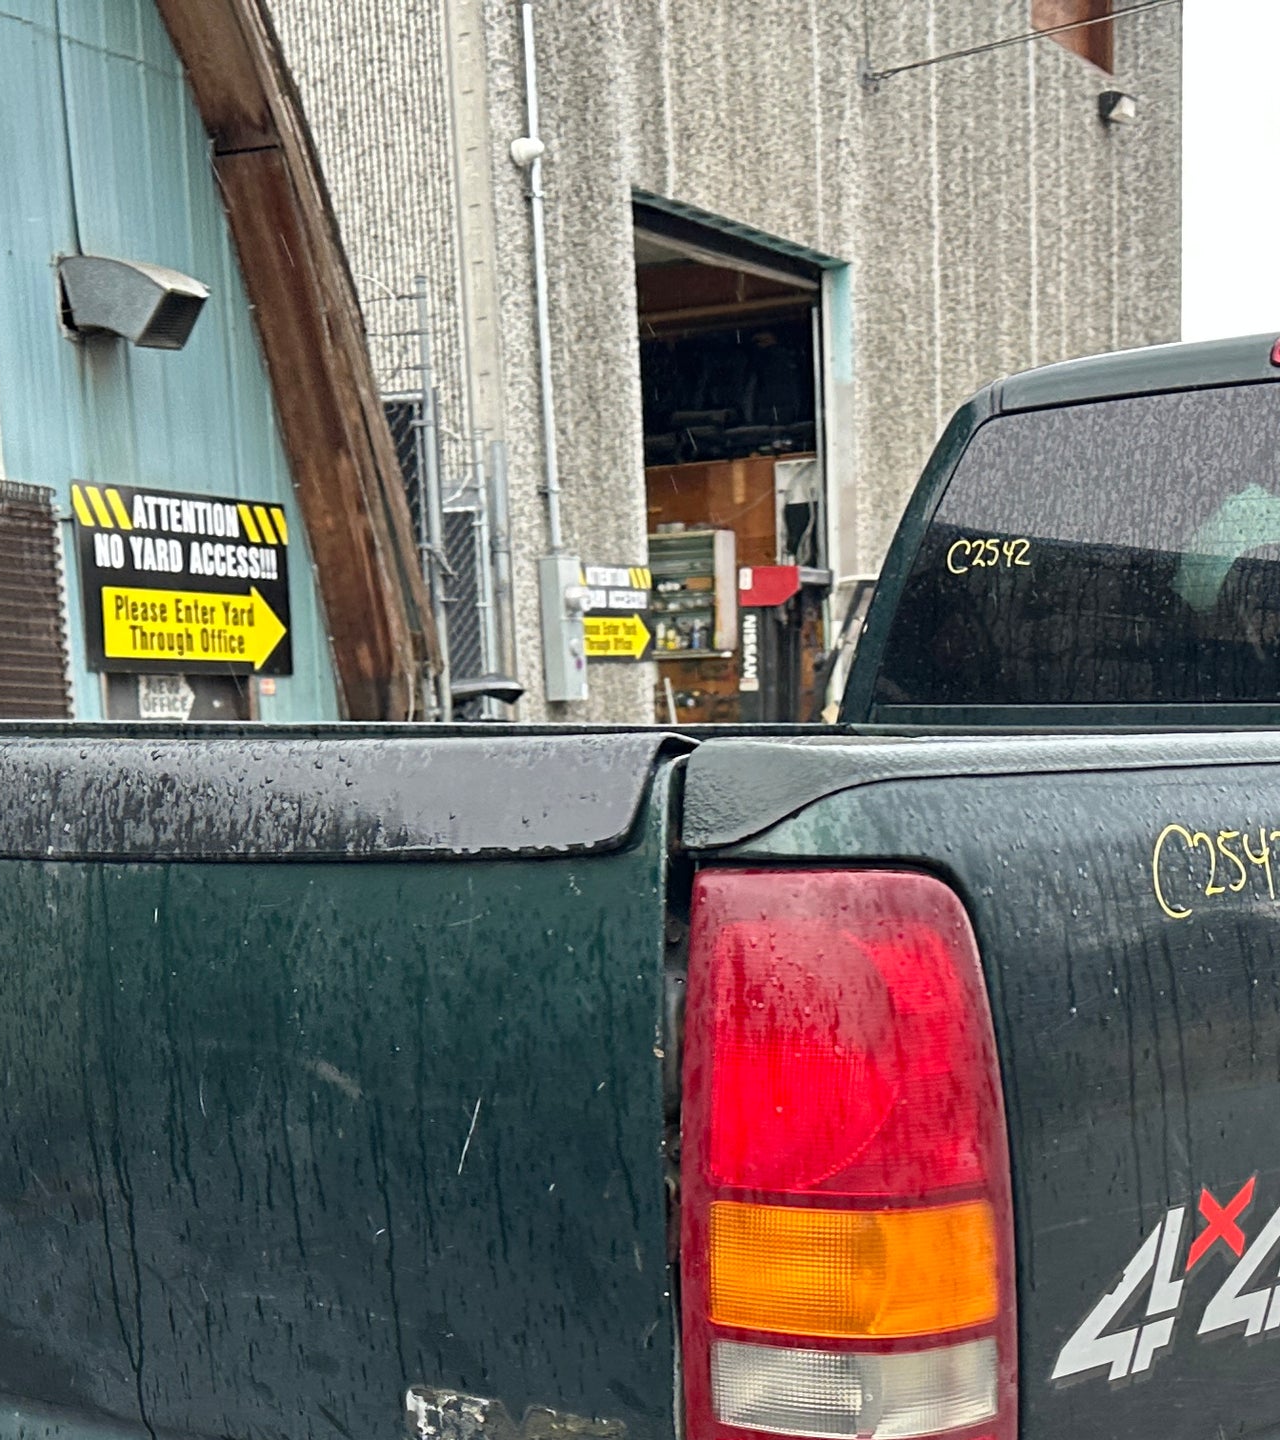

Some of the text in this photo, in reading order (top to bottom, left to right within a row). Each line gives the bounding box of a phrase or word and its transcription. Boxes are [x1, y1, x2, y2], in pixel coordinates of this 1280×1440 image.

[132, 494, 240, 538] ATTENTION
[94, 532, 279, 580] NO YARD ACCESS!!!
[946, 538, 1032, 575] C2542
[114, 594, 255, 627] Please Enter Yard
[129, 625, 246, 657] Through Office
[742, 613, 758, 679] NISSAN
[143, 693, 190, 713] OFFICE
